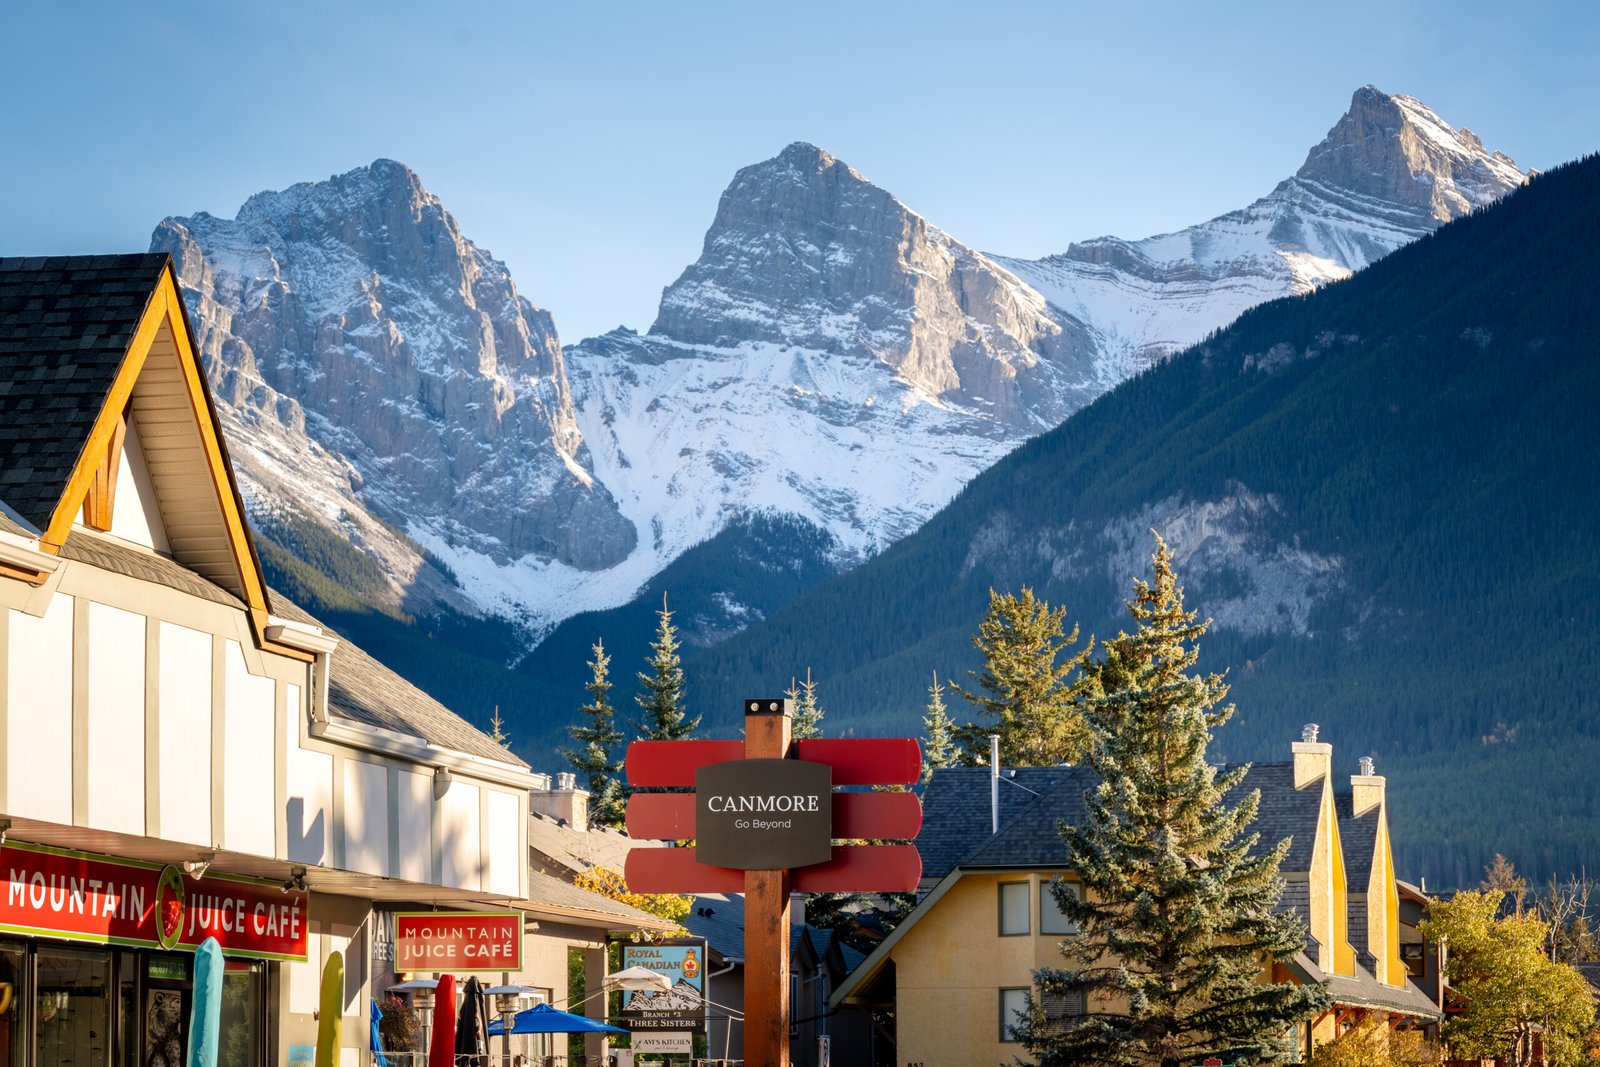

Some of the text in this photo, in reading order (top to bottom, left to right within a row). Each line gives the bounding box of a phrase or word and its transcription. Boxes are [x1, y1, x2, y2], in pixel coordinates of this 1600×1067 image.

[708, 795, 819, 812] CANMORE
[735, 819, 792, 831] Go Beyond
[8, 868, 300, 939] MOUNTAIN JUICE CAFÉ
[405, 927, 513, 940] MOUNTAIN
[404, 940, 513, 960] JUICE CAFÉ
[627, 948, 662, 958] ROYAL
[627, 1018, 696, 1027] THREE SISTERS
[661, 1038, 691, 1046] KITCHEN
